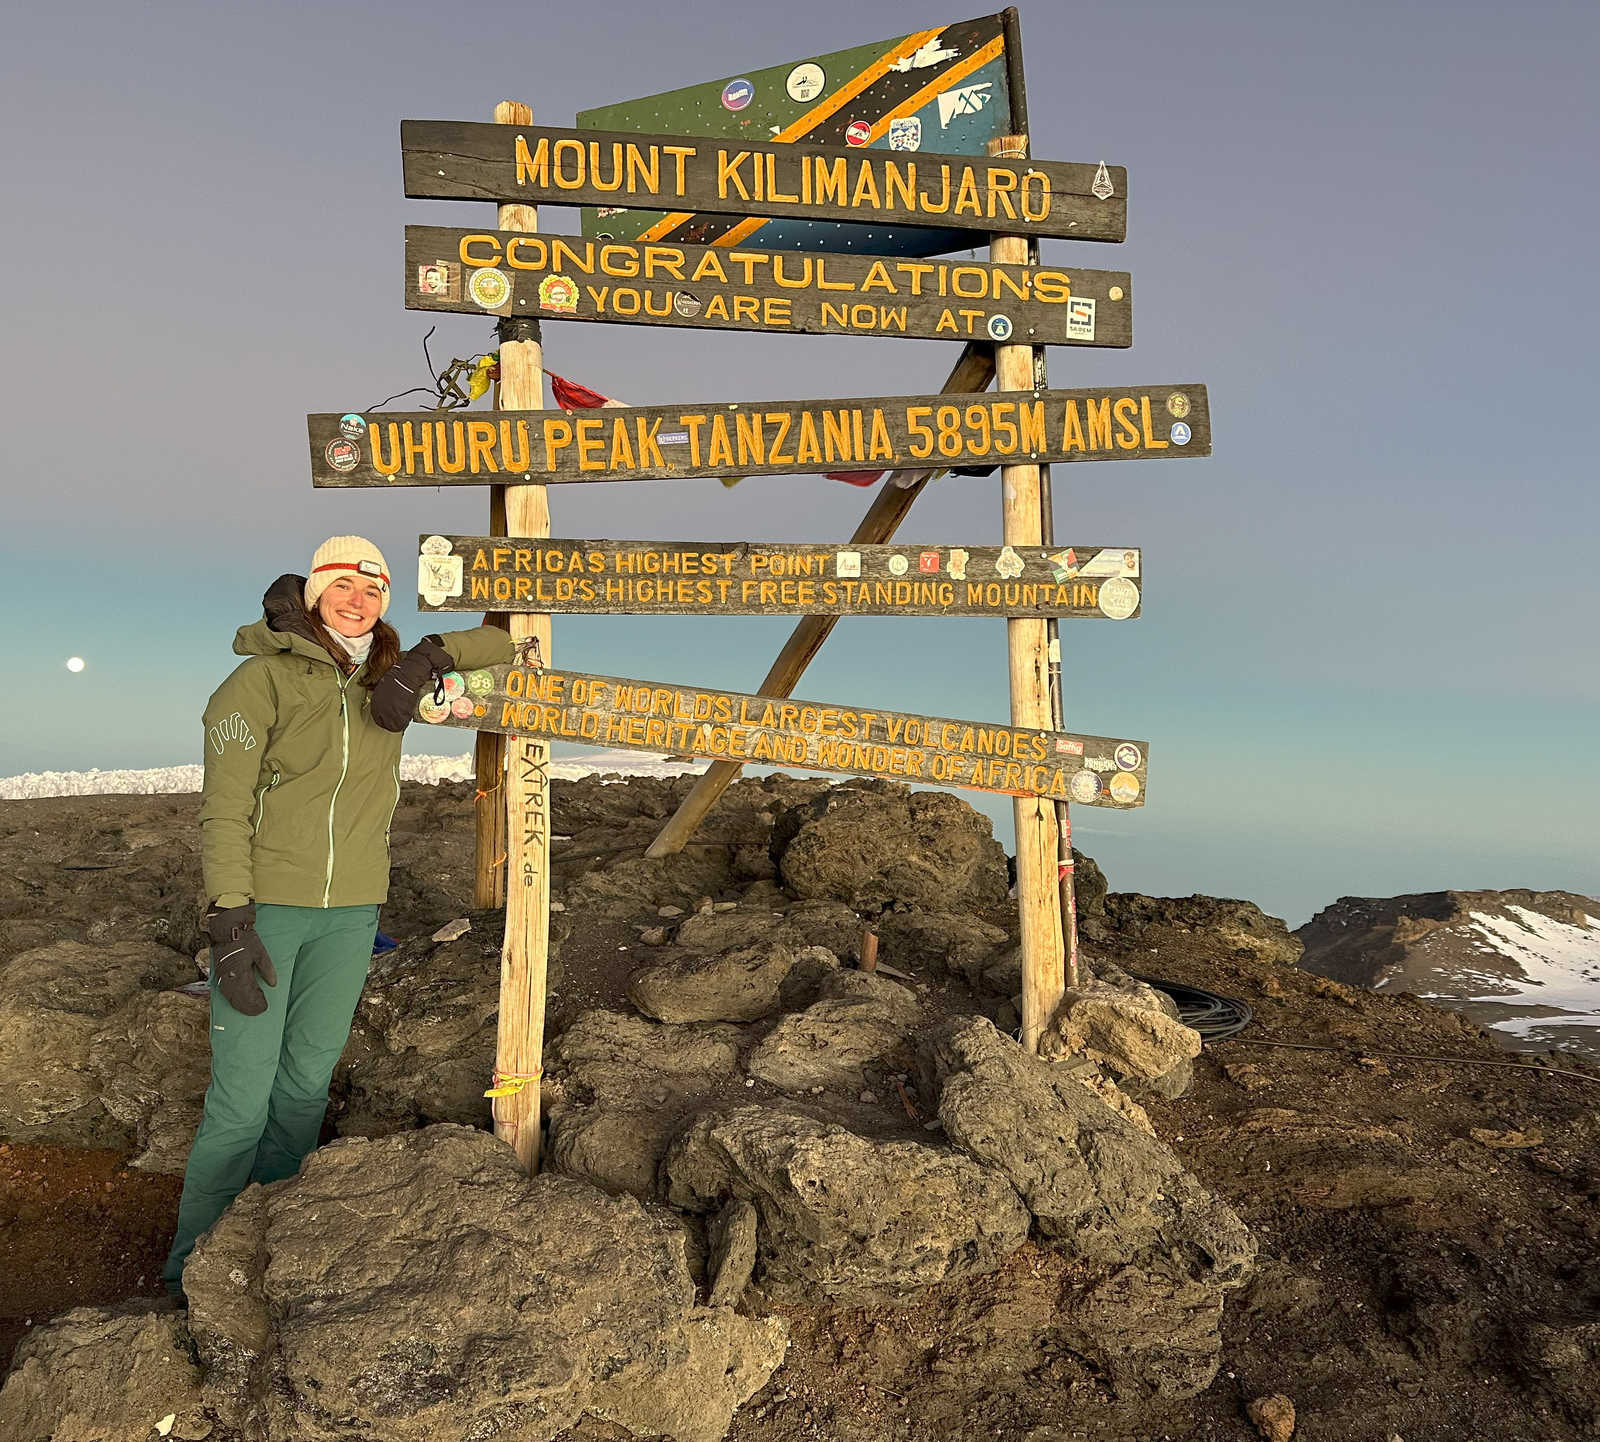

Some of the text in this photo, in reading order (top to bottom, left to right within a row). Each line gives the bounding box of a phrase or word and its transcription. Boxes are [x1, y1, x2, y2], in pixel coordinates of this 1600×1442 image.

[515, 137, 1052, 223] MOUNT KILIMANJARO
[458, 233, 1072, 304] CONGRATULATIONS
[586, 285, 673, 317] YOU
[703, 294, 792, 326] ARE
[820, 301, 908, 332] NOW
[935, 308, 985, 334] AT
[368, 418, 530, 475] UHURU
[906, 401, 1048, 459] 5895M
[1062, 395, 1169, 451] AMSL
[470, 575, 597, 602] WORLD'S
[605, 578, 734, 604] HIGHEST
[741, 579, 815, 605] FREE
[822, 580, 956, 606] STANDING
[967, 582, 1099, 608] MOUNTAIN
[614, 551, 738, 576] HIGHEST
[750, 553, 832, 577] POINT
[500, 700, 601, 739] WORLD
[606, 714, 747, 757] HERITAGE
[753, 732, 809, 764] AND
[816, 739, 927, 779] WONDER
[931, 753, 966, 782] OF
[970, 758, 1067, 797] AFRICA
[505, 669, 566, 703] ONE
[571, 678, 609, 707] OF
[739, 699, 878, 740] LARGEST
[886, 716, 1049, 762] VOLCANOES
